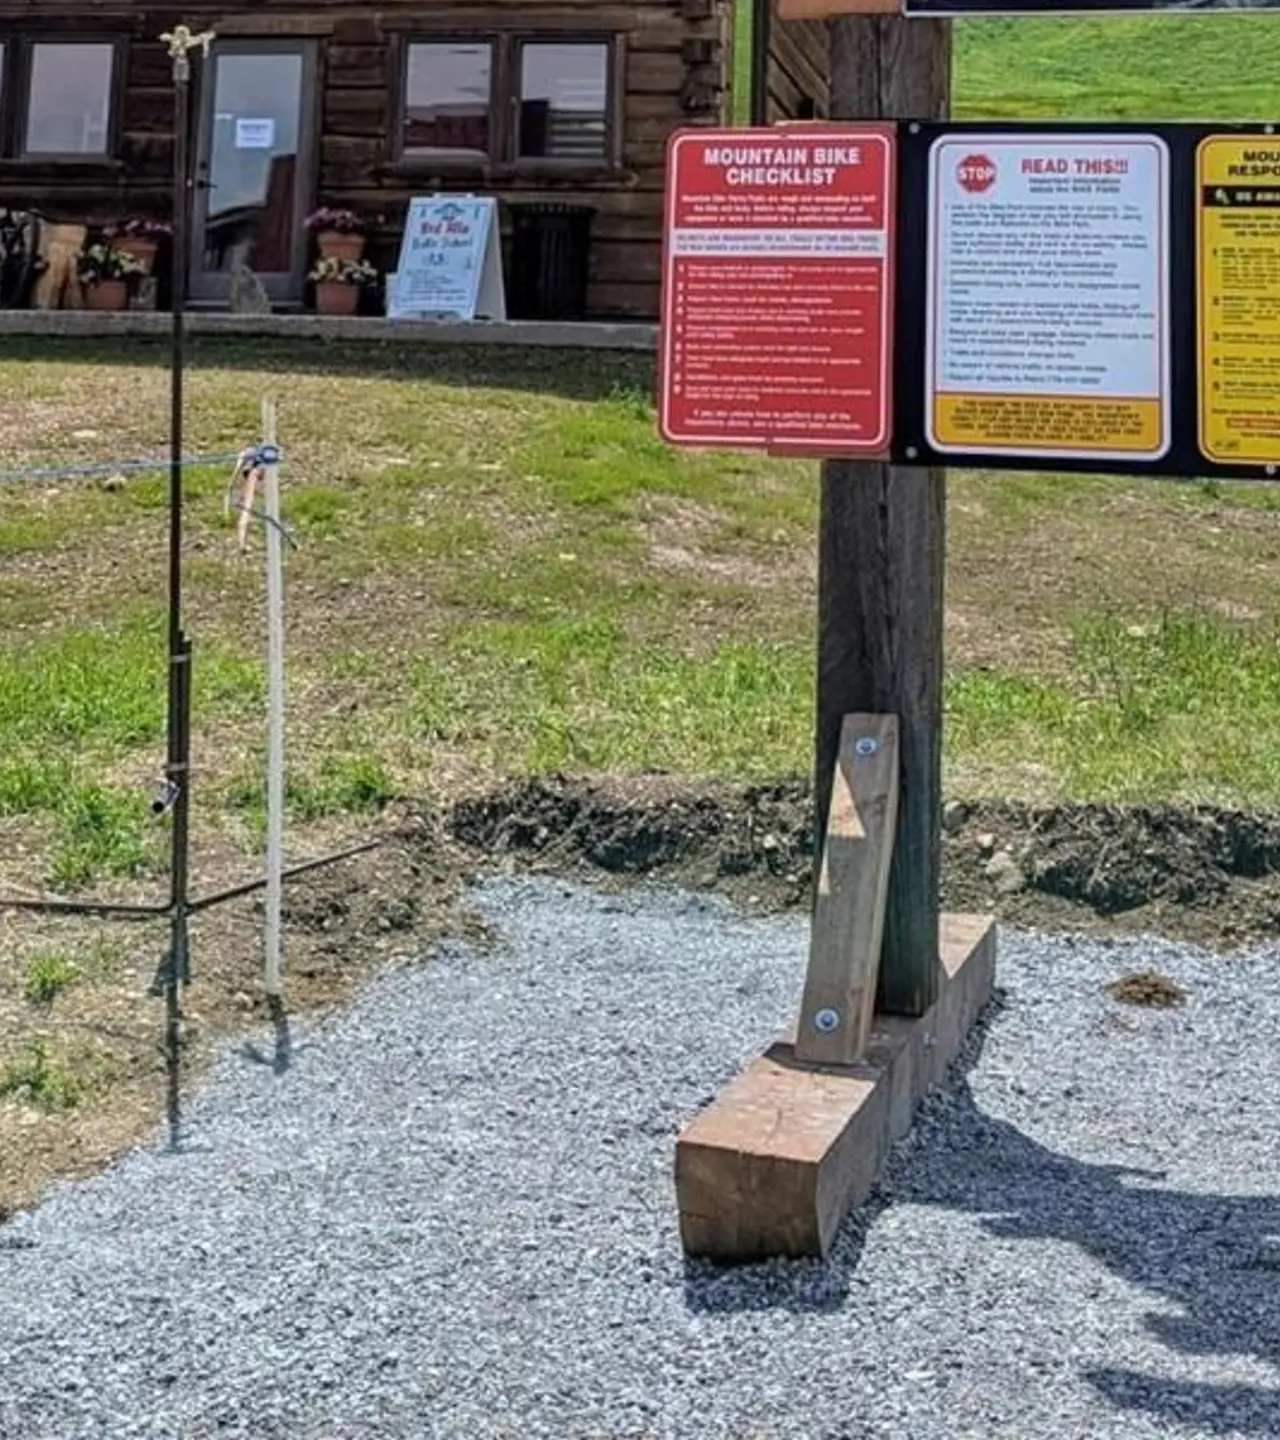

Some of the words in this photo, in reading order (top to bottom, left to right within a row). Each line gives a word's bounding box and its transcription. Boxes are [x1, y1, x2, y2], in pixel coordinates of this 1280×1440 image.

[704, 148, 808, 166] MOUNTAIN
[813, 147, 861, 165] BIKE
[958, 166, 996, 181] STOP
[1021, 158, 1068, 174] READ
[725, 168, 837, 186] CHECKLIST
[1235, 192, 1252, 202] BE
